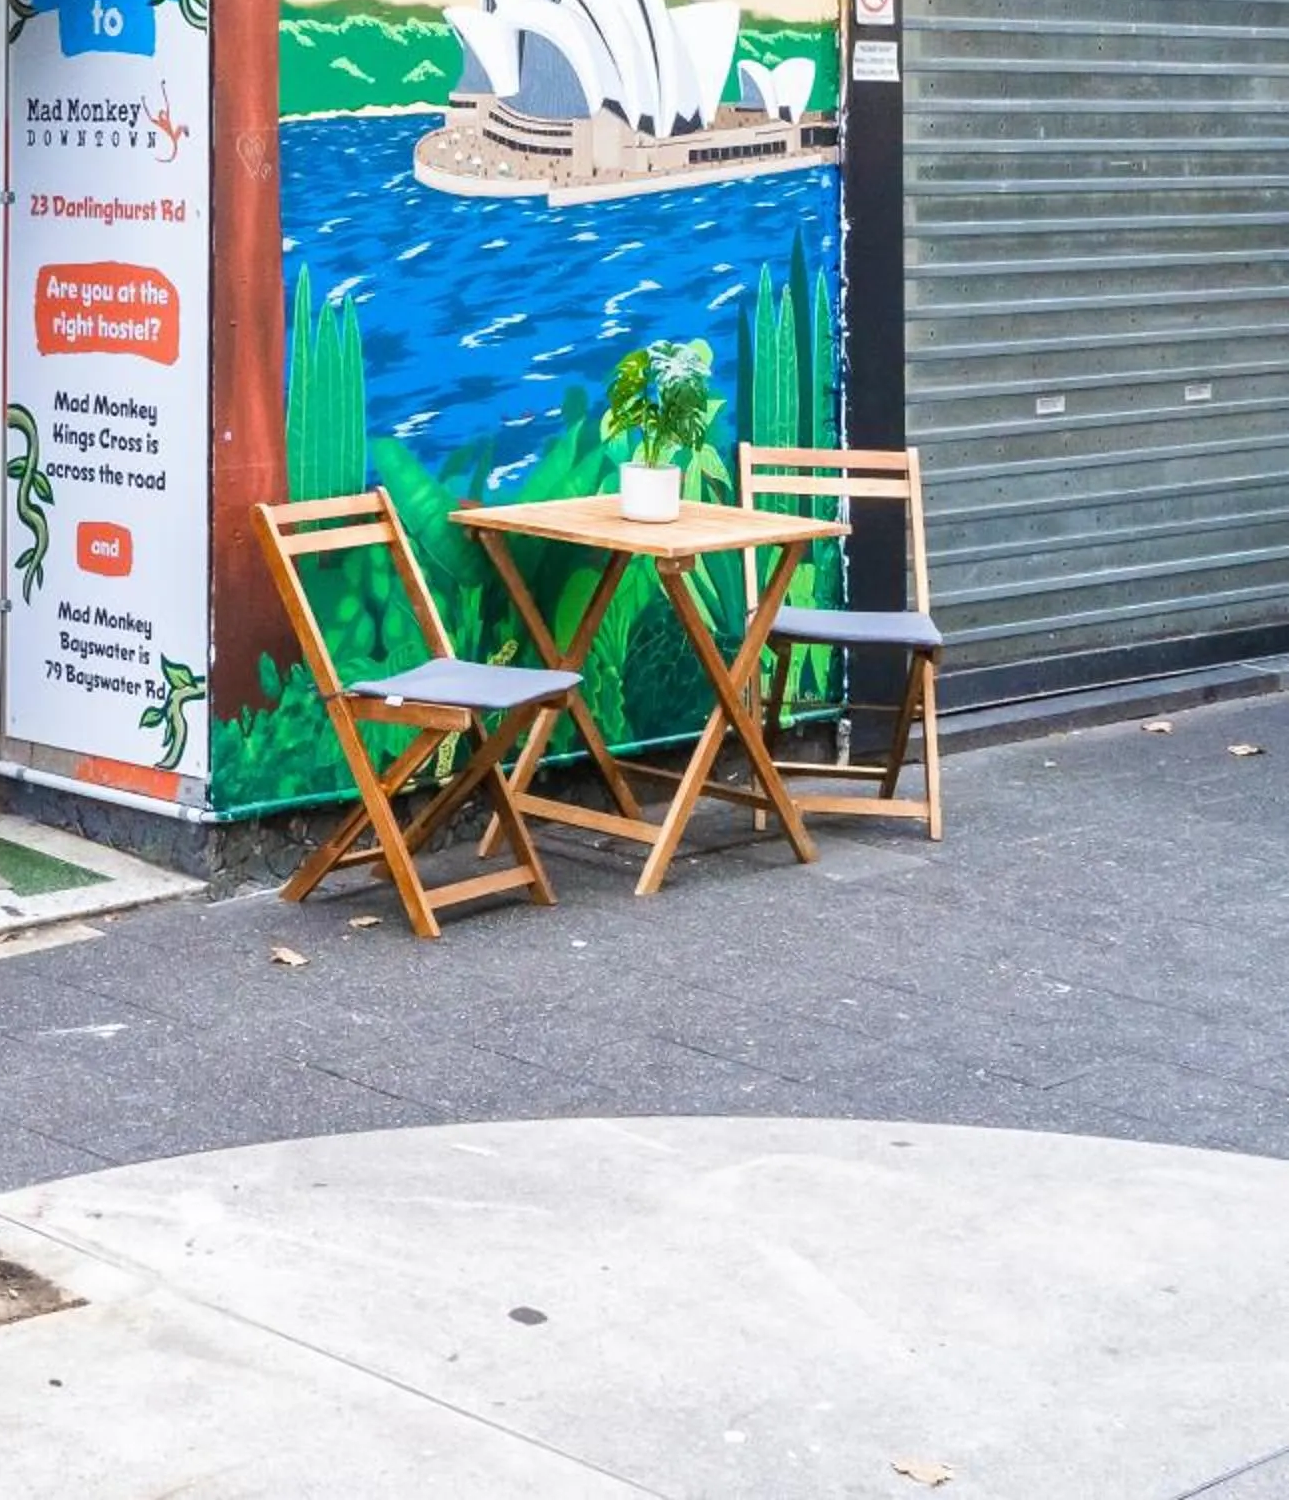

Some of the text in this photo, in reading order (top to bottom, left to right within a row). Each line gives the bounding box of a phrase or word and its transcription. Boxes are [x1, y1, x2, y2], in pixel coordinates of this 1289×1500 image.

[92, 0, 124, 37] to
[27, 98, 141, 129] Mad Monkey
[27, 129, 159, 150] DOWNTOWN
[30, 194, 186, 225] 23 Darlinghurst Rd
[46, 275, 168, 307] Are you at the
[53, 311, 162, 342] right hostel?
[54, 390, 158, 426] Mad Monkey
[53, 422, 159, 455] Kings Cross is
[46, 461, 166, 490] across the road
[91, 538, 120, 557] and
[58, 601, 152, 640] Mad Monkey
[59, 631, 150, 665] Bayswater is
[45, 660, 166, 701] 79 Bayswater Rd
